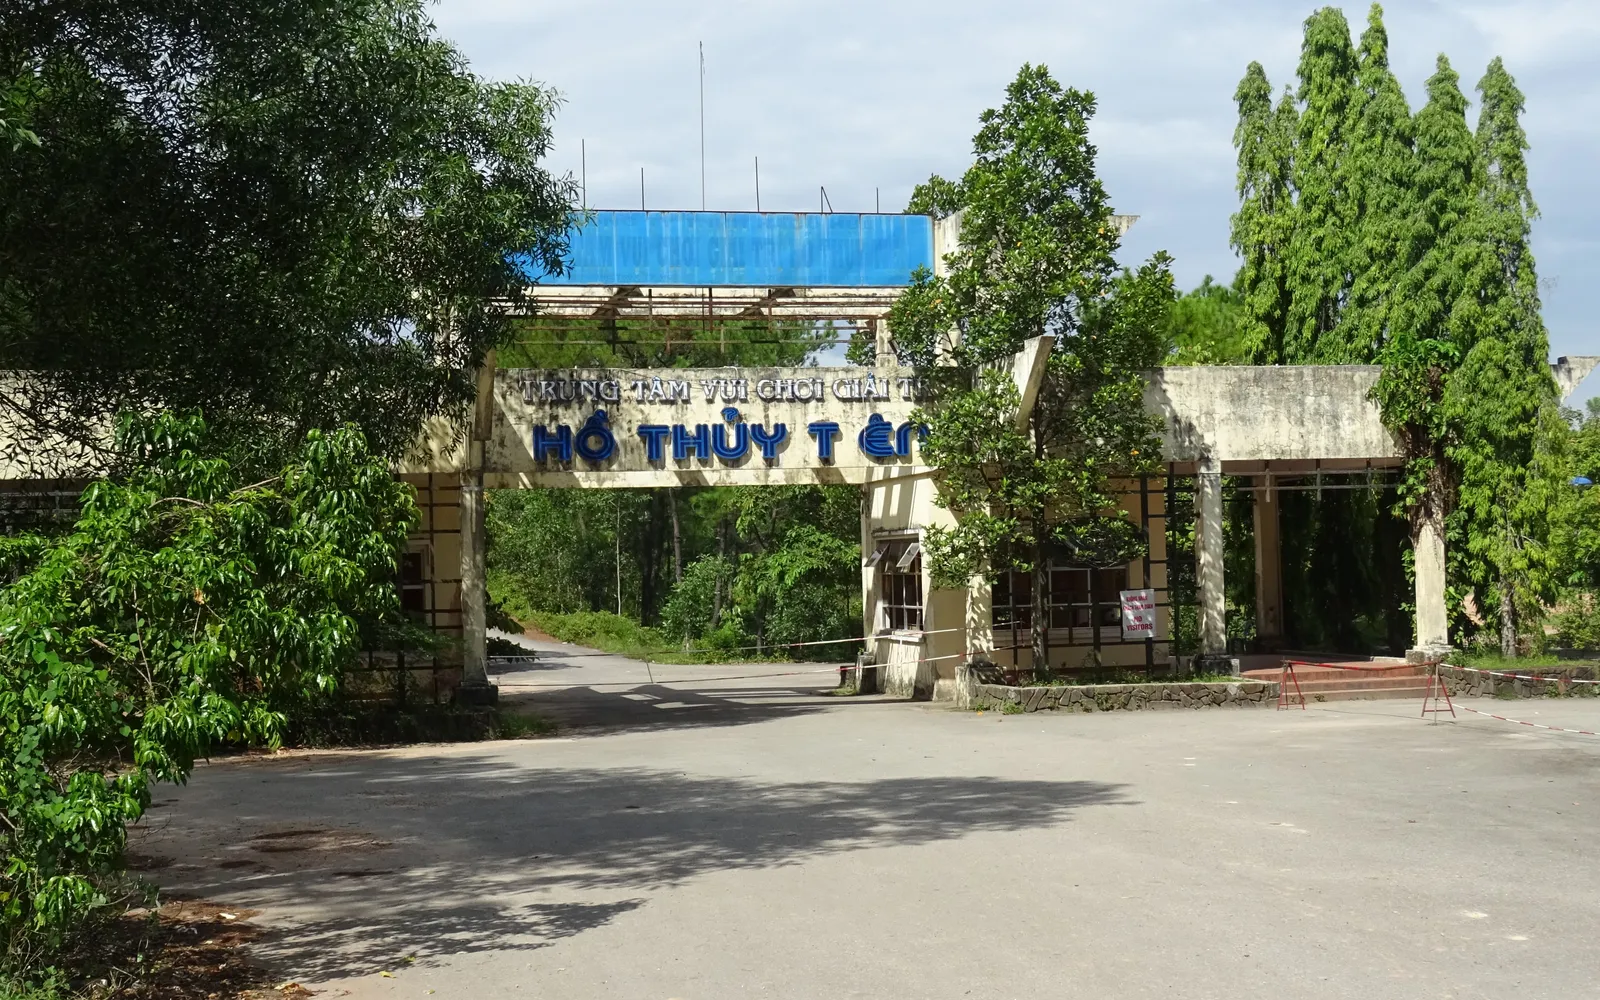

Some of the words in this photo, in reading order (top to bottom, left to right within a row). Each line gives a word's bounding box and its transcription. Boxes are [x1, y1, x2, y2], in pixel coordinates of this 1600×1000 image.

[519, 379, 620, 403] TRUNG
[632, 375, 692, 403] TÂM
[701, 378, 750, 402] VUI
[832, 371, 890, 401] GIẢI
[897, 377, 933, 399] TR
[532, 408, 616, 461] HỒ
[637, 407, 787, 460] THỦY
[1127, 623, 1153, 631] VISITORS
